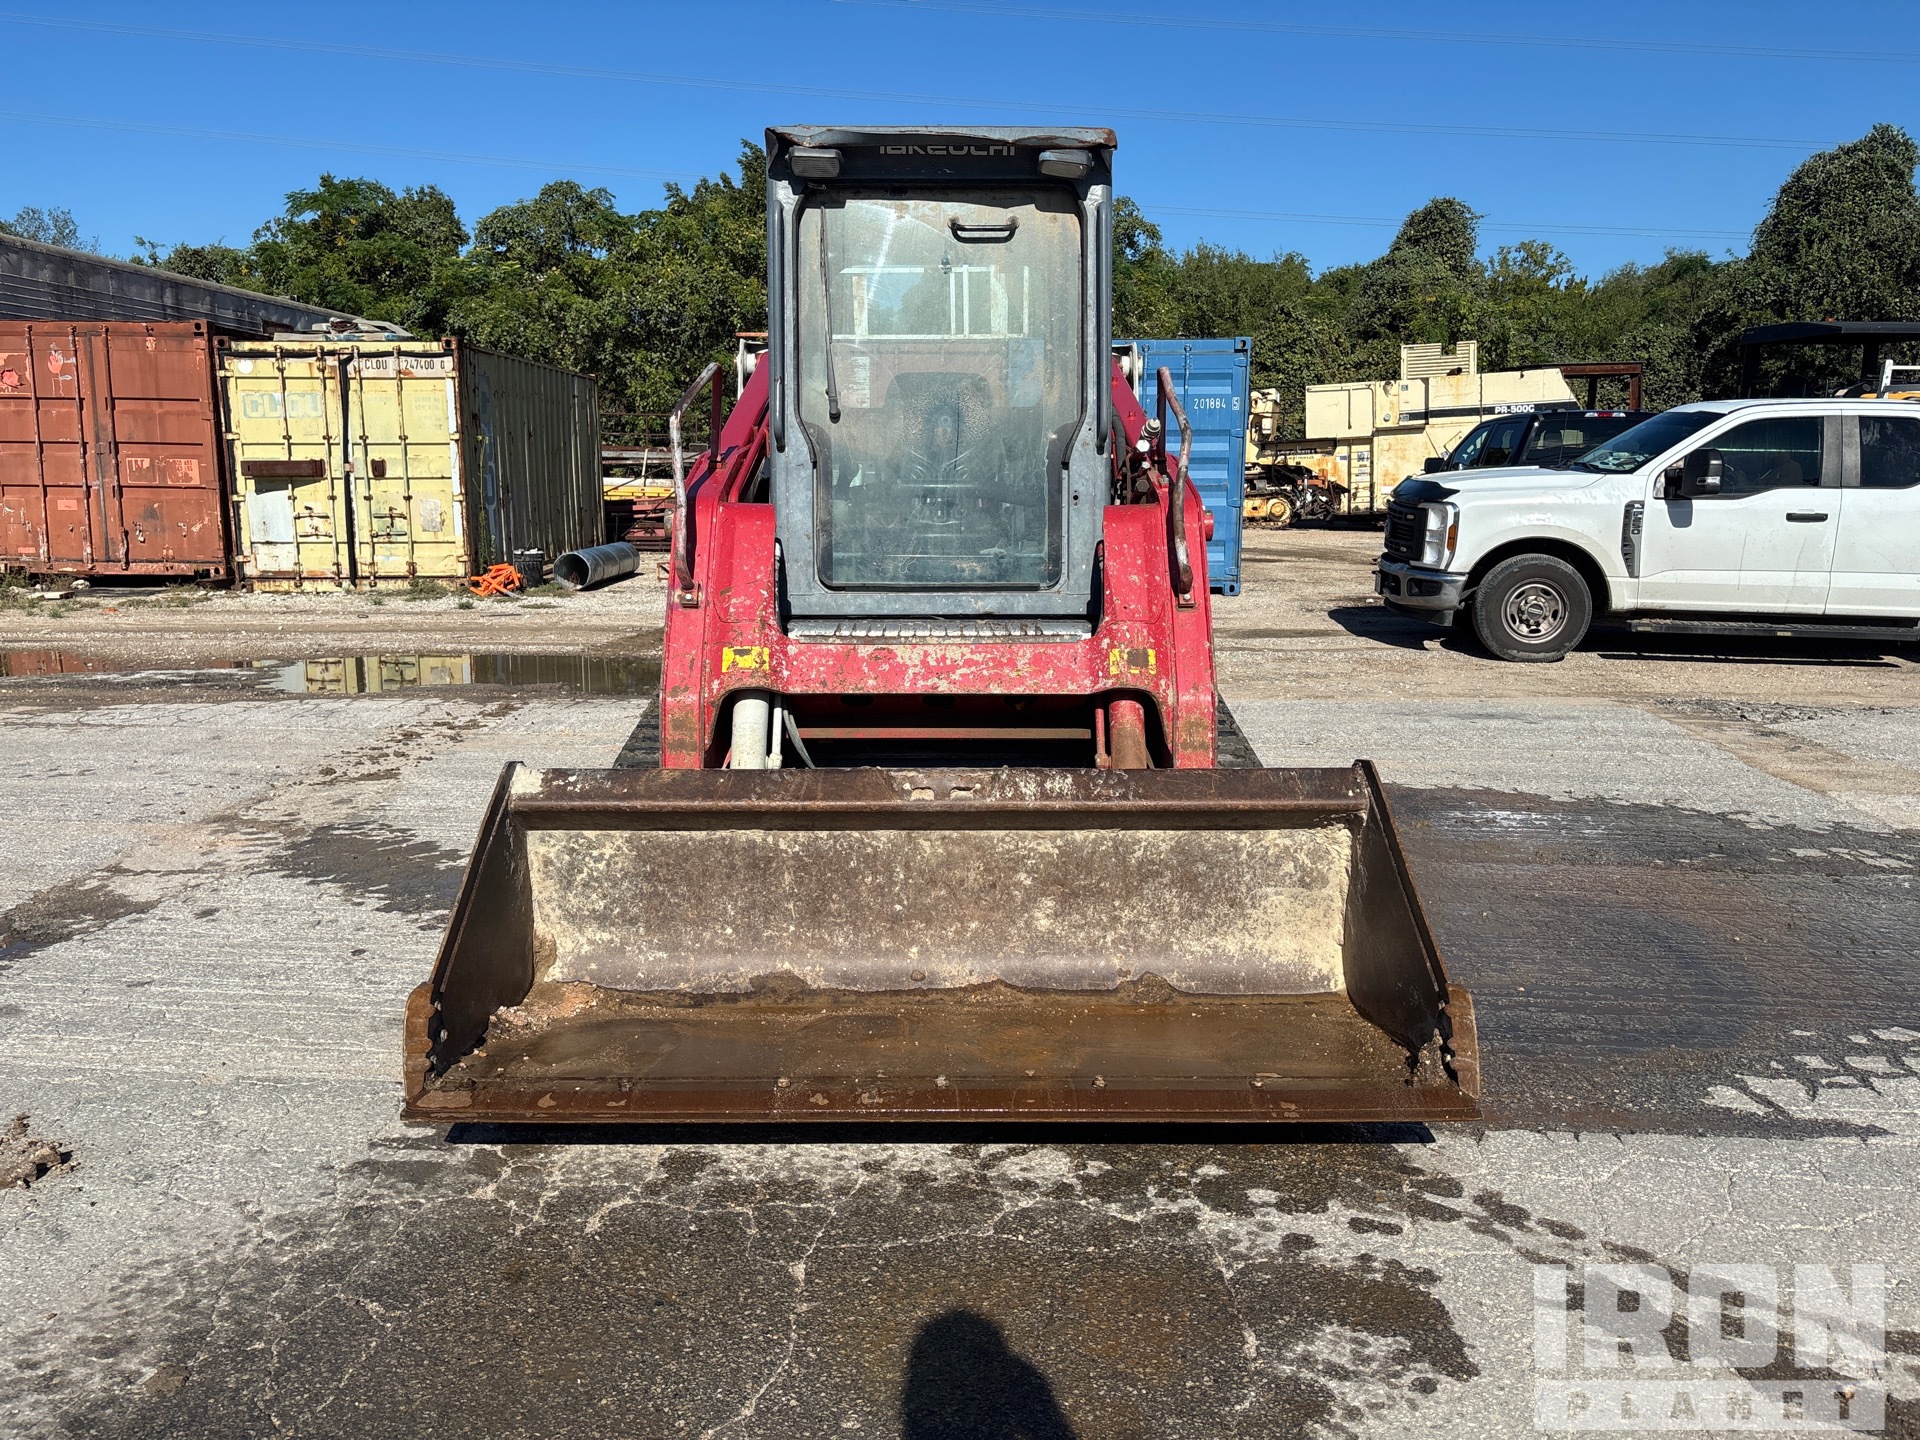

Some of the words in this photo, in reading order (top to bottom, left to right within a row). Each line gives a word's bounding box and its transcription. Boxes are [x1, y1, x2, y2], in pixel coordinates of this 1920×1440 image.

[364, 359, 387, 369] CLOU
[405, 359, 434, 369] 247400
[1193, 398, 1226, 409] 201884
[1232, 397, 1239, 410] 5
[1495, 404, 1535, 414] PR-500C
